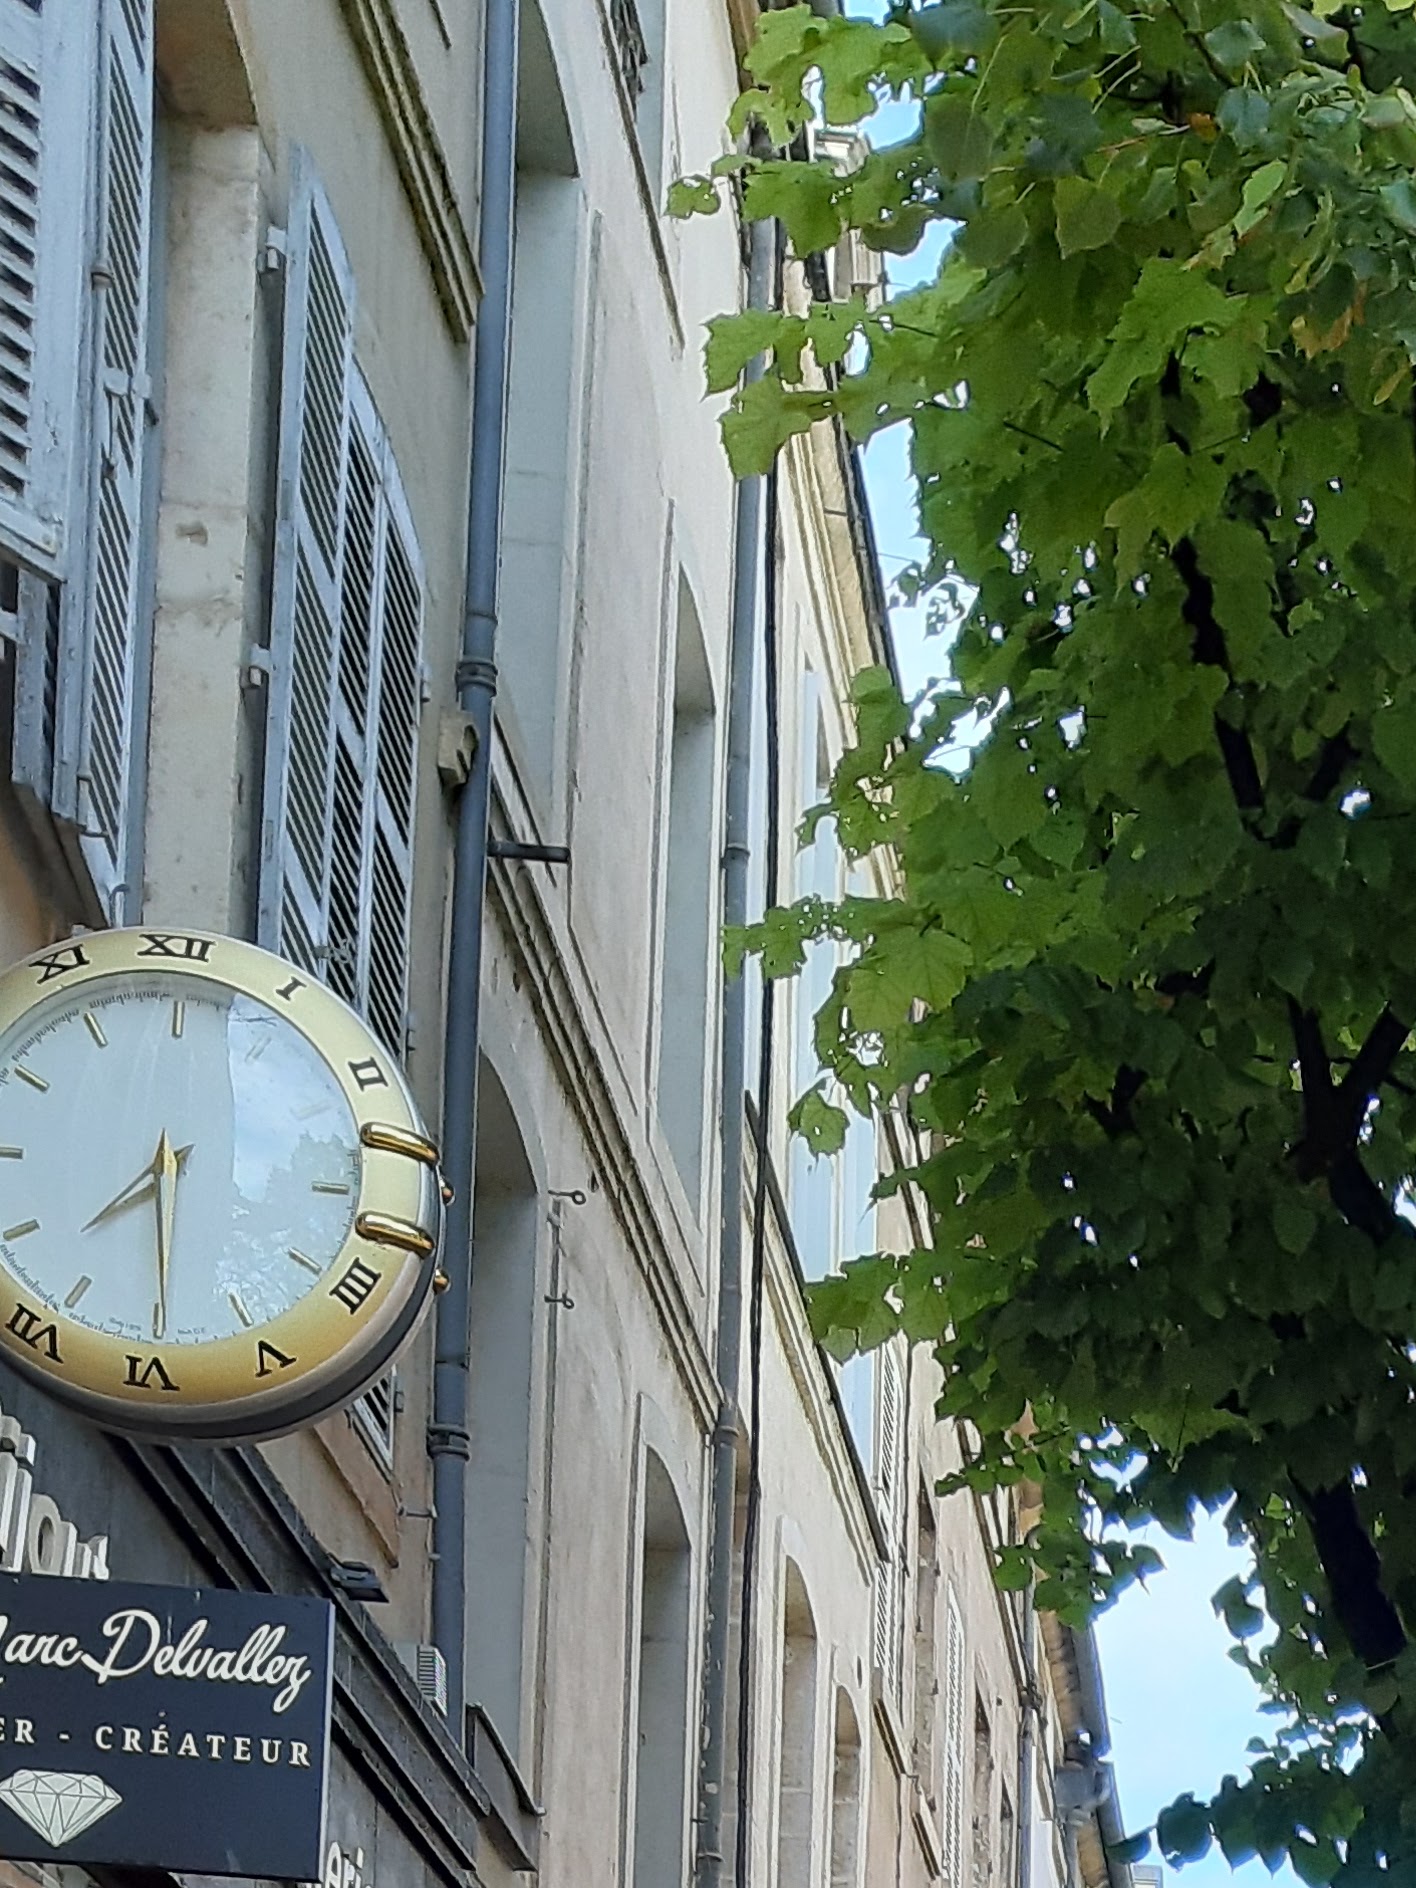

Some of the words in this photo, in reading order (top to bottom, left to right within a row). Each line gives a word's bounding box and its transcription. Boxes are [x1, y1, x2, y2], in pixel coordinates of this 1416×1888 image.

[29, 944, 90, 984] XI
[137, 934, 217, 963] XII
[276, 977, 307, 1001] I
[348, 1057, 389, 1092] II
[329, 1256, 382, 1315] IIII
[5, 1304, 64, 1364] VII
[124, 1354, 181, 1393] VI
[255, 1340, 298, 1377] V
[0, 1615, 84, 1667] arc
[81, 1608, 313, 1714] Delvallez
[95, 1725, 312, 1768] CRÉATEUR
